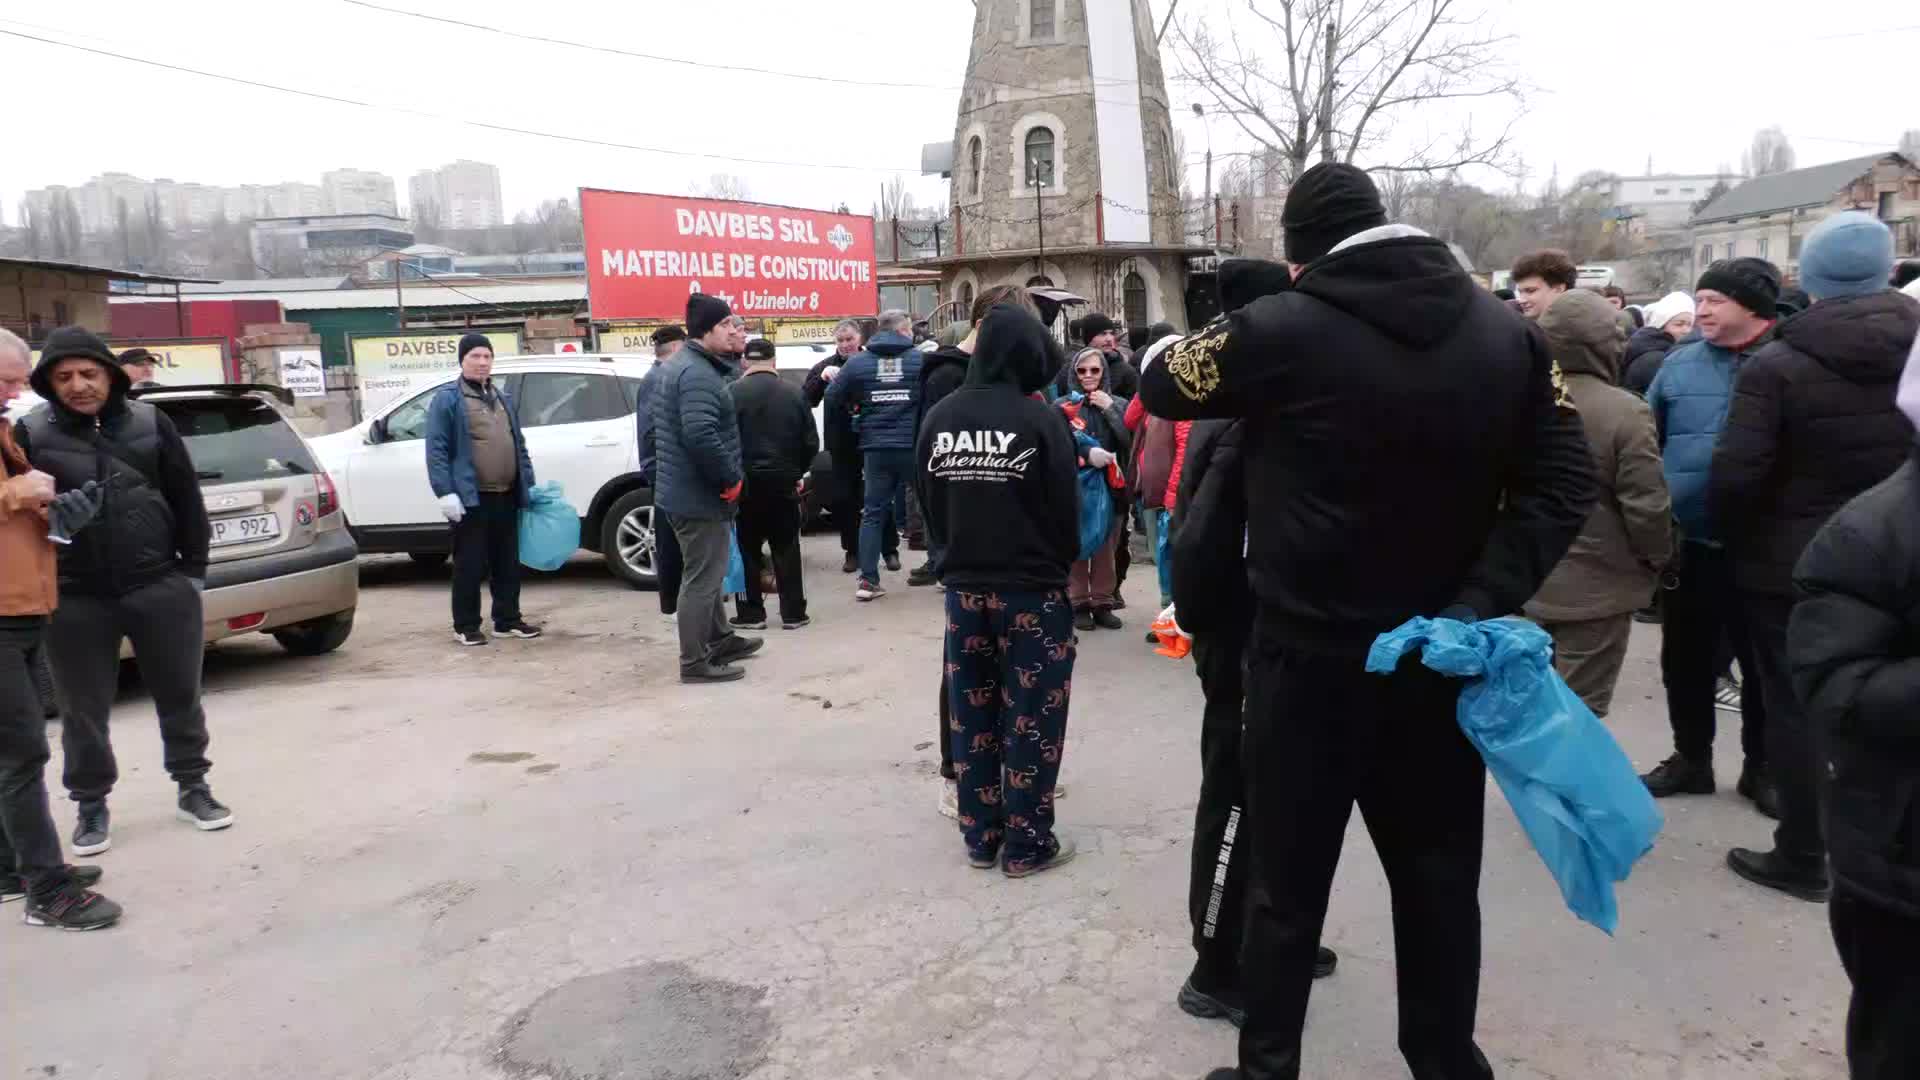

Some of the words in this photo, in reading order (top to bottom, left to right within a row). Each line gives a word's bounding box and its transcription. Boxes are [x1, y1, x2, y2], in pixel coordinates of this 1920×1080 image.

[676, 208, 775, 241] DAVBES
[778, 217, 820, 245] SRL
[602, 249, 725, 277] MATERIALE
[730, 253, 756, 278] DE
[760, 255, 870, 290] CONSTRUCȚIE
[711, 290, 739, 310] tr.
[743, 287, 807, 310] Uzinelor
[809, 291, 820, 311] 8
[623, 336, 656, 348] DAVB
[792, 327, 827, 338] DAVBES
[386, 340, 457, 356] DAVBES
[936, 430, 1017, 454] DAILY
[928, 441, 1037, 472] Essentials
[240, 517, 271, 536] 992
